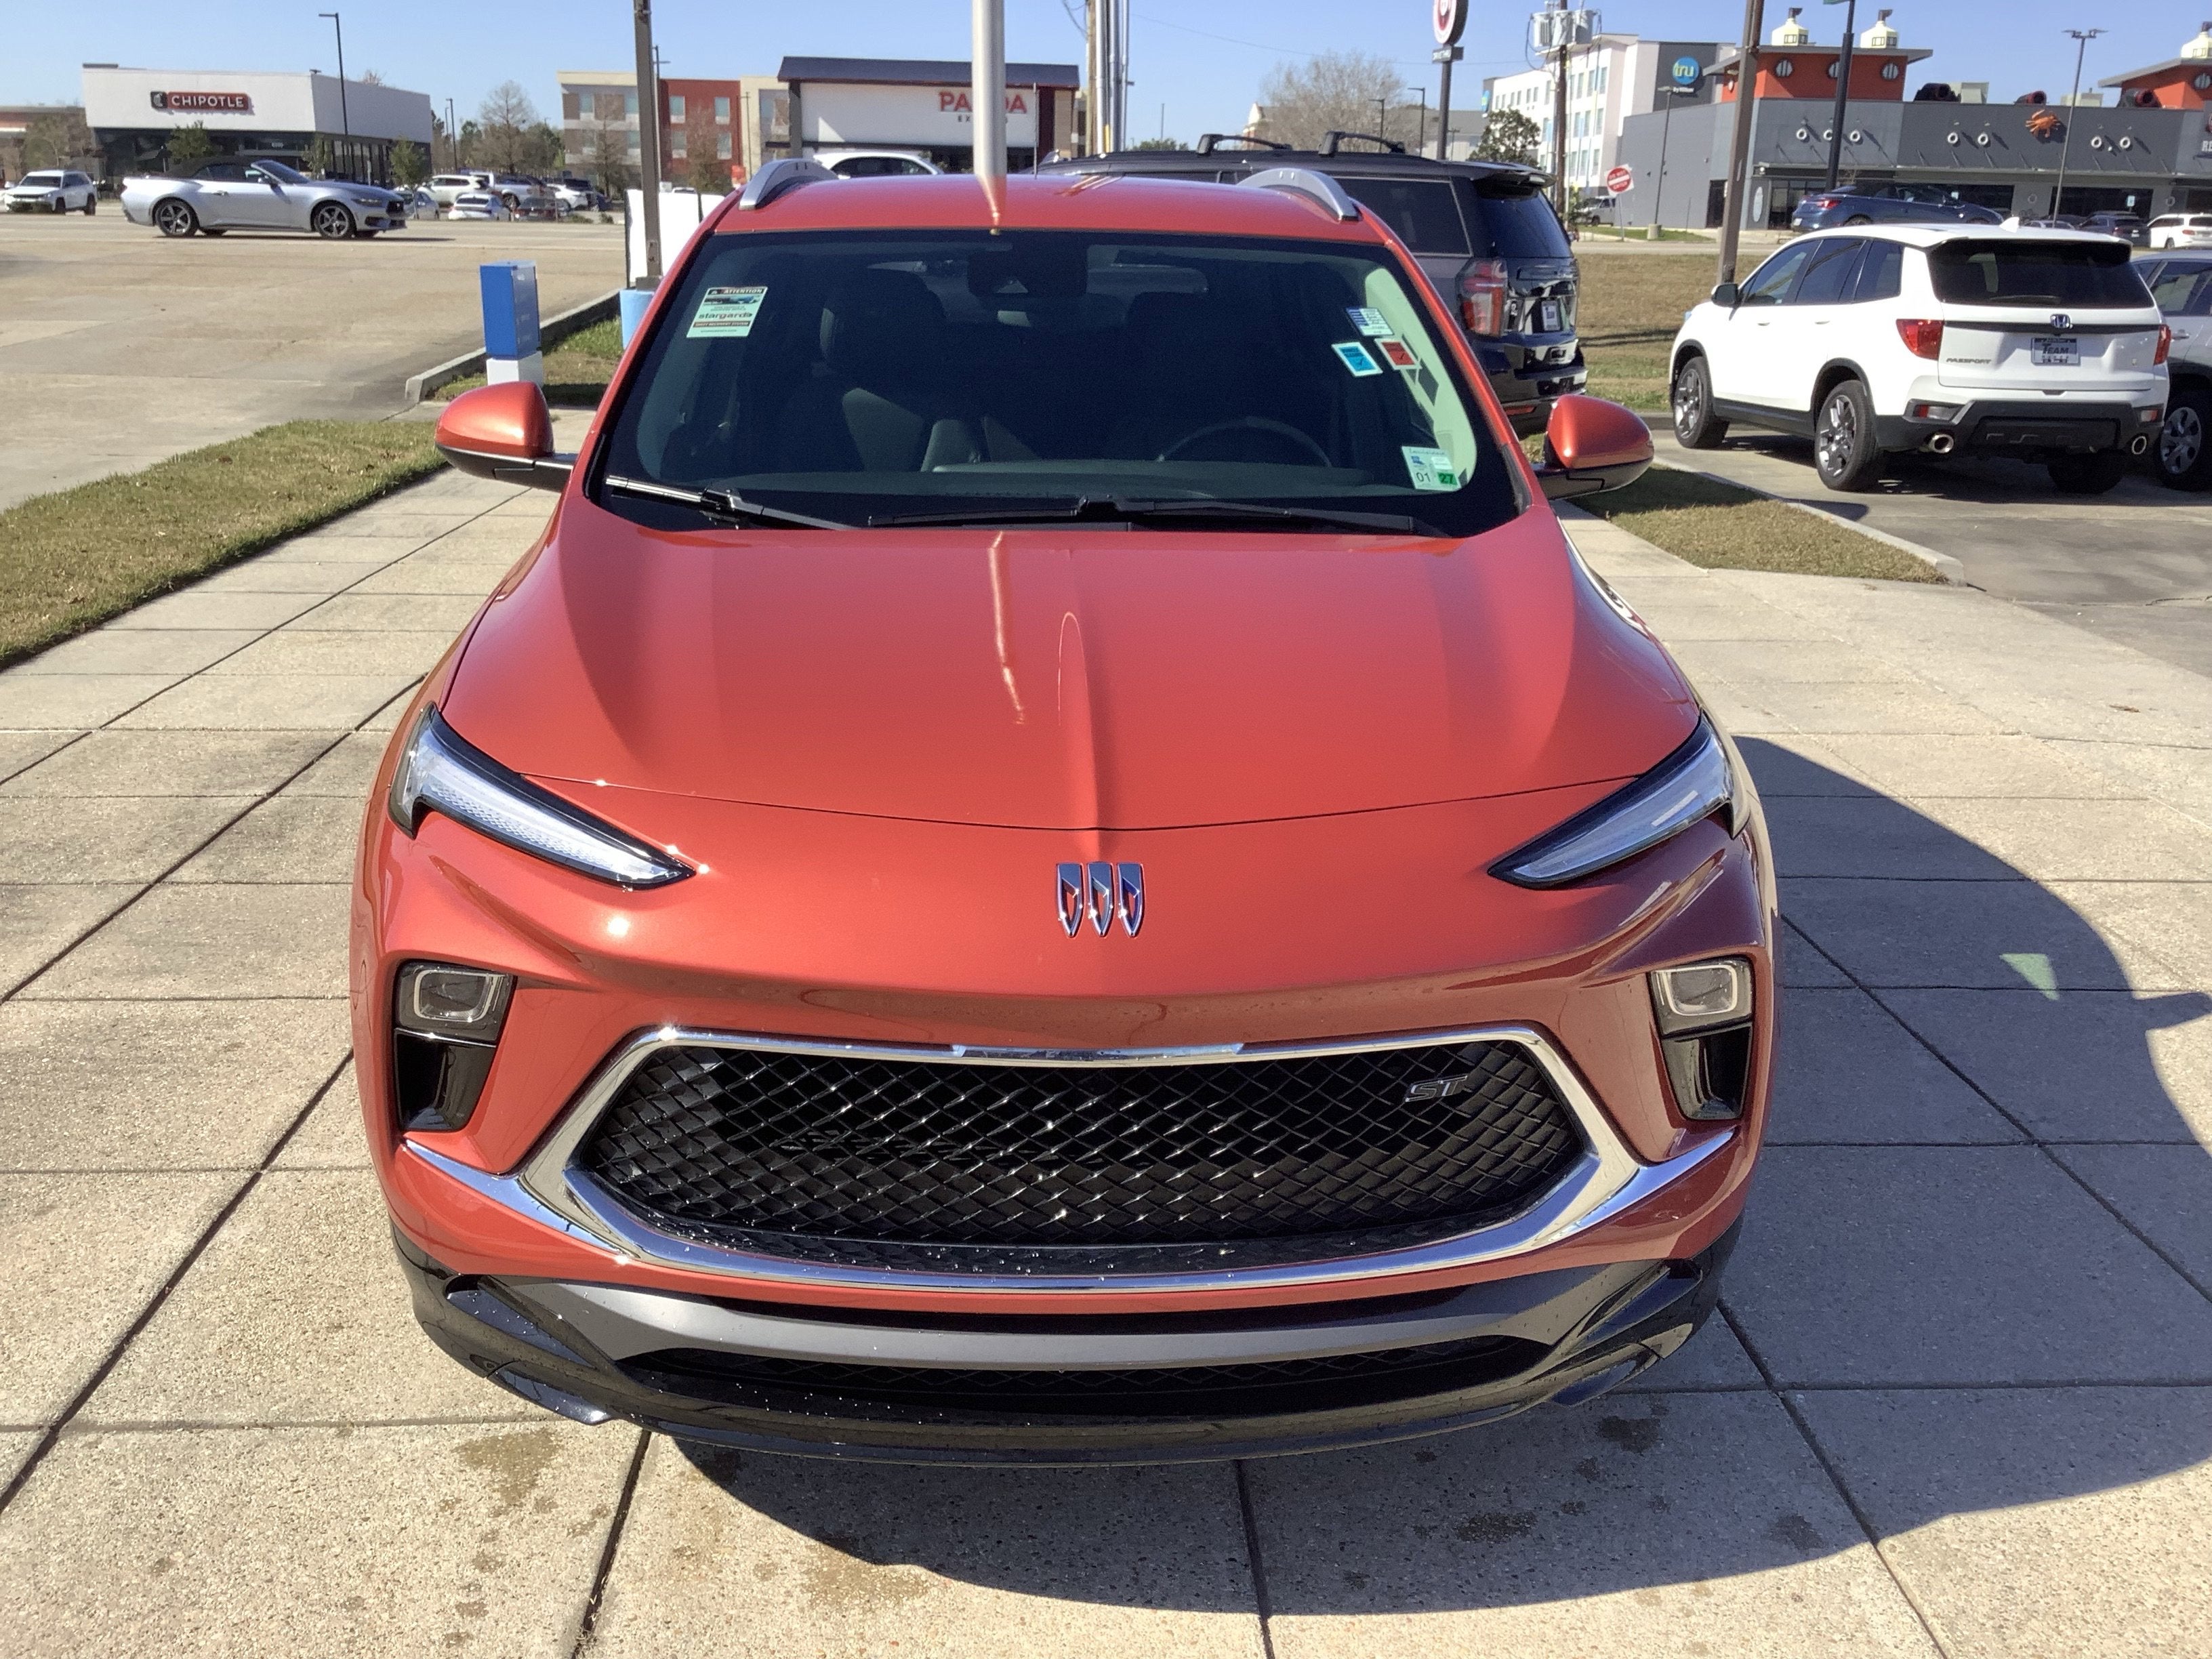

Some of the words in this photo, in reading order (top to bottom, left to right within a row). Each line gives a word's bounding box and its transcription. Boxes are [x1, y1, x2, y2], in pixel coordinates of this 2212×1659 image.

[1673, 62, 1694, 77] tru
[171, 95, 244, 108] CHIPOTLE
[939, 91, 1027, 114] PAA
[1416, 472, 1431, 483] 01
[1437, 472, 1454, 485] 27
[1405, 1075, 1468, 1103] ST
